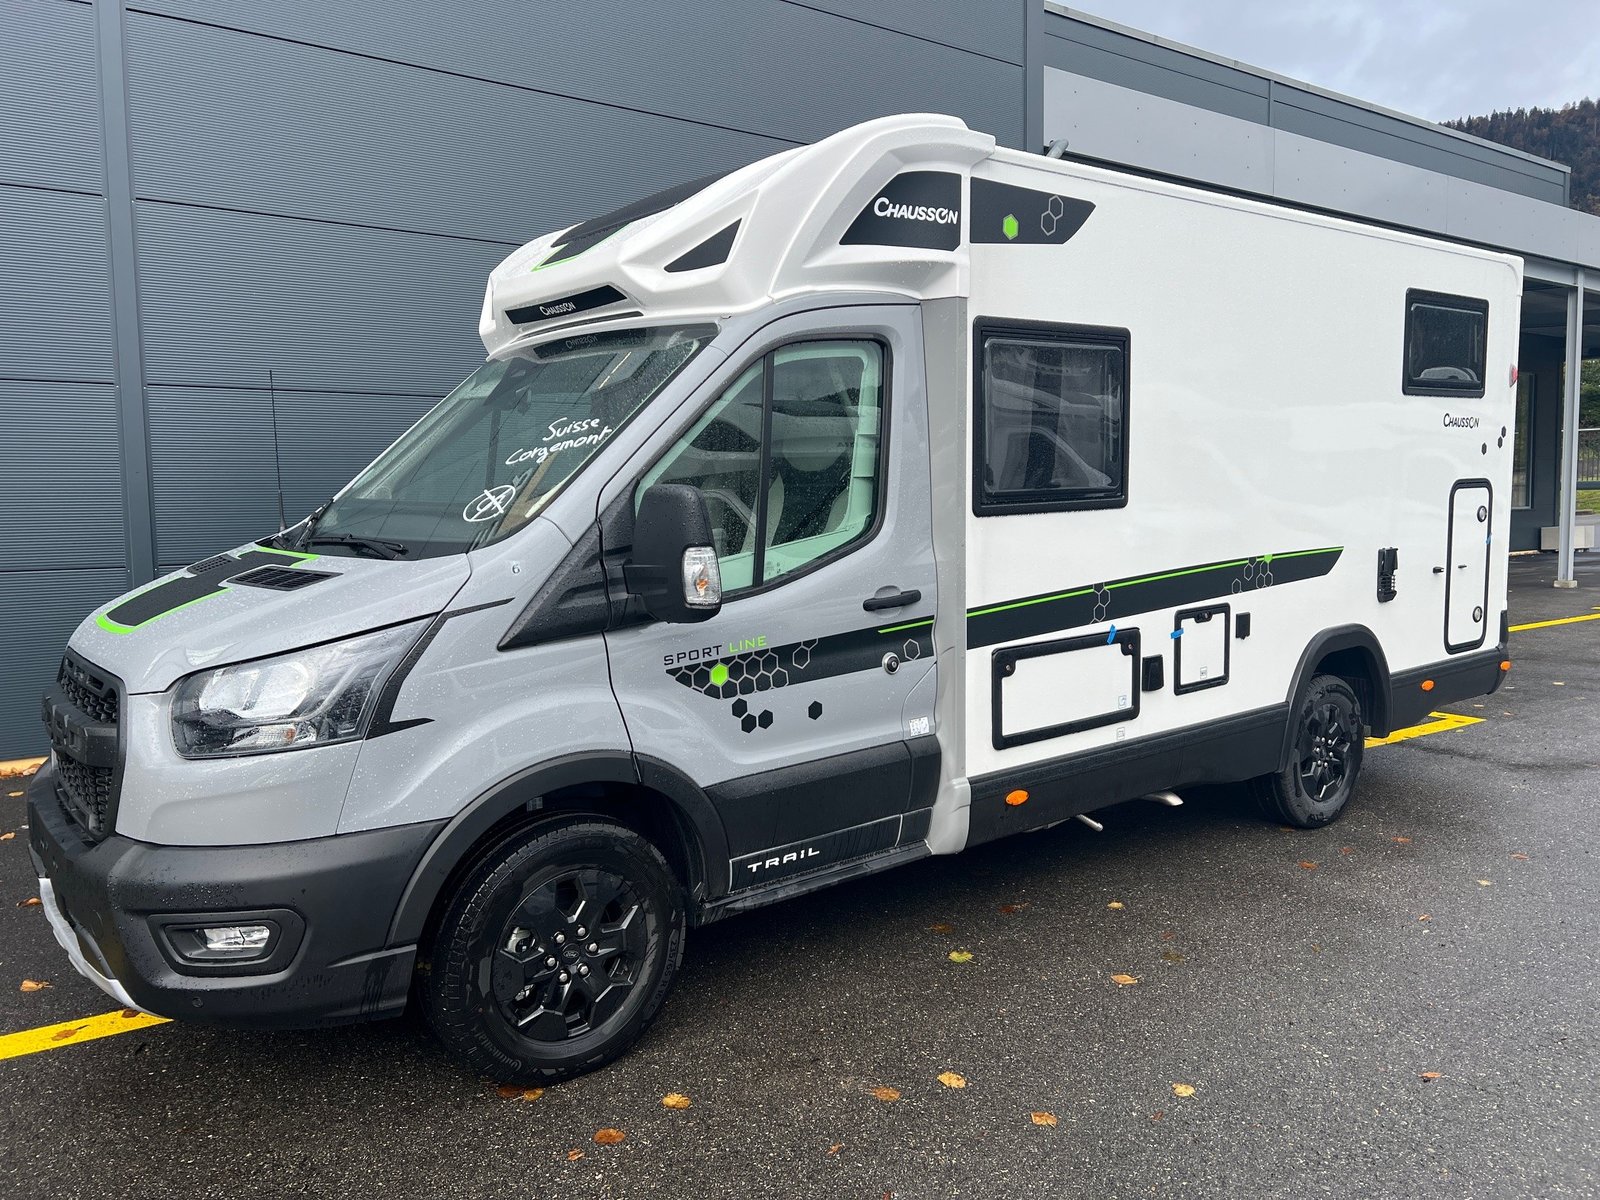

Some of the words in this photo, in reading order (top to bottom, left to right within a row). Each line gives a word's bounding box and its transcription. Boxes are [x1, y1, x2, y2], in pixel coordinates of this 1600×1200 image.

[873, 196, 959, 225] CHAUSSON
[540, 301, 577, 316] CHAUSSON
[542, 416, 600, 441] Suisse
[1443, 412, 1480, 429] CHAUSSON
[505, 425, 613, 465] Corgemont
[663, 644, 723, 666] SPORT
[728, 635, 768, 653] LINE
[747, 847, 820, 873] TRAIL
